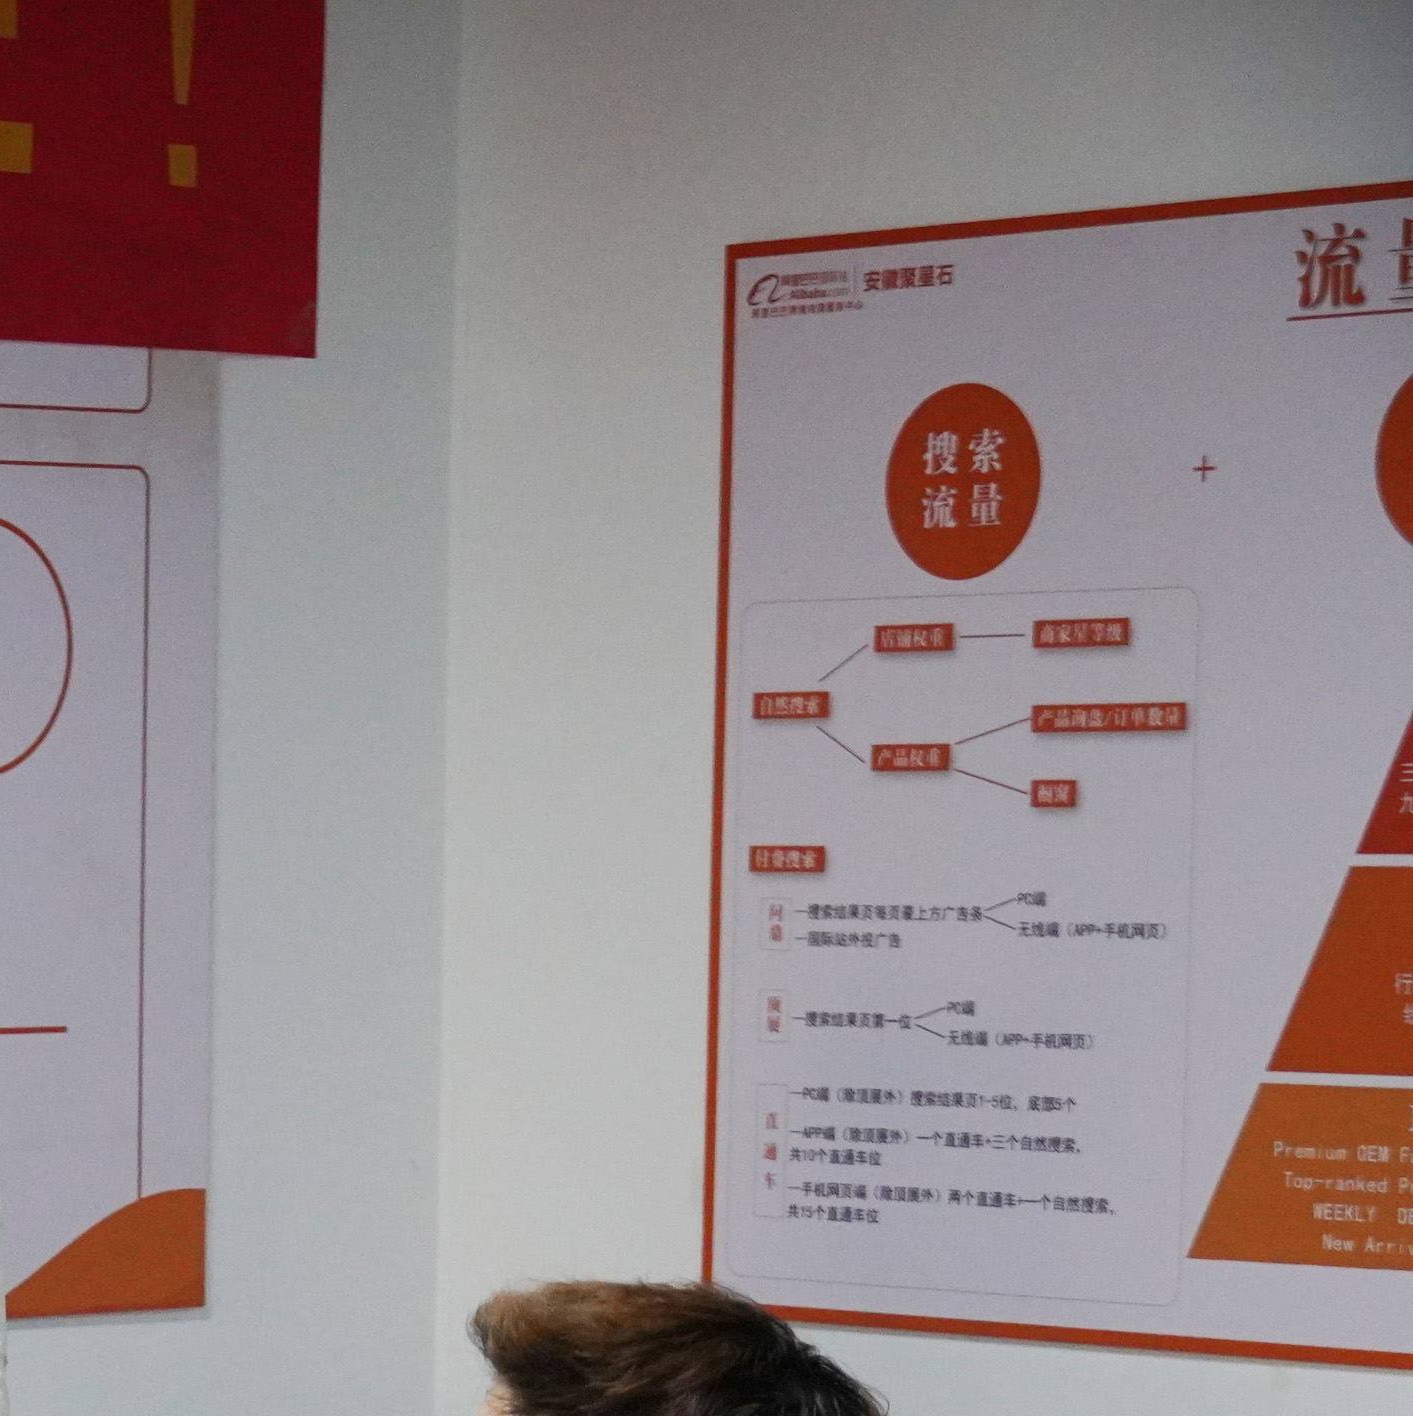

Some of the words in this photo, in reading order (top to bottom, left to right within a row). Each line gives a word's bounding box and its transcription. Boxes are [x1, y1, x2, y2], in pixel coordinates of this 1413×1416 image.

[922, 428, 1007, 475] 搜索
[921, 484, 1004, 529] 流量
[1313, 1203, 1376, 1222] WEEKLY
